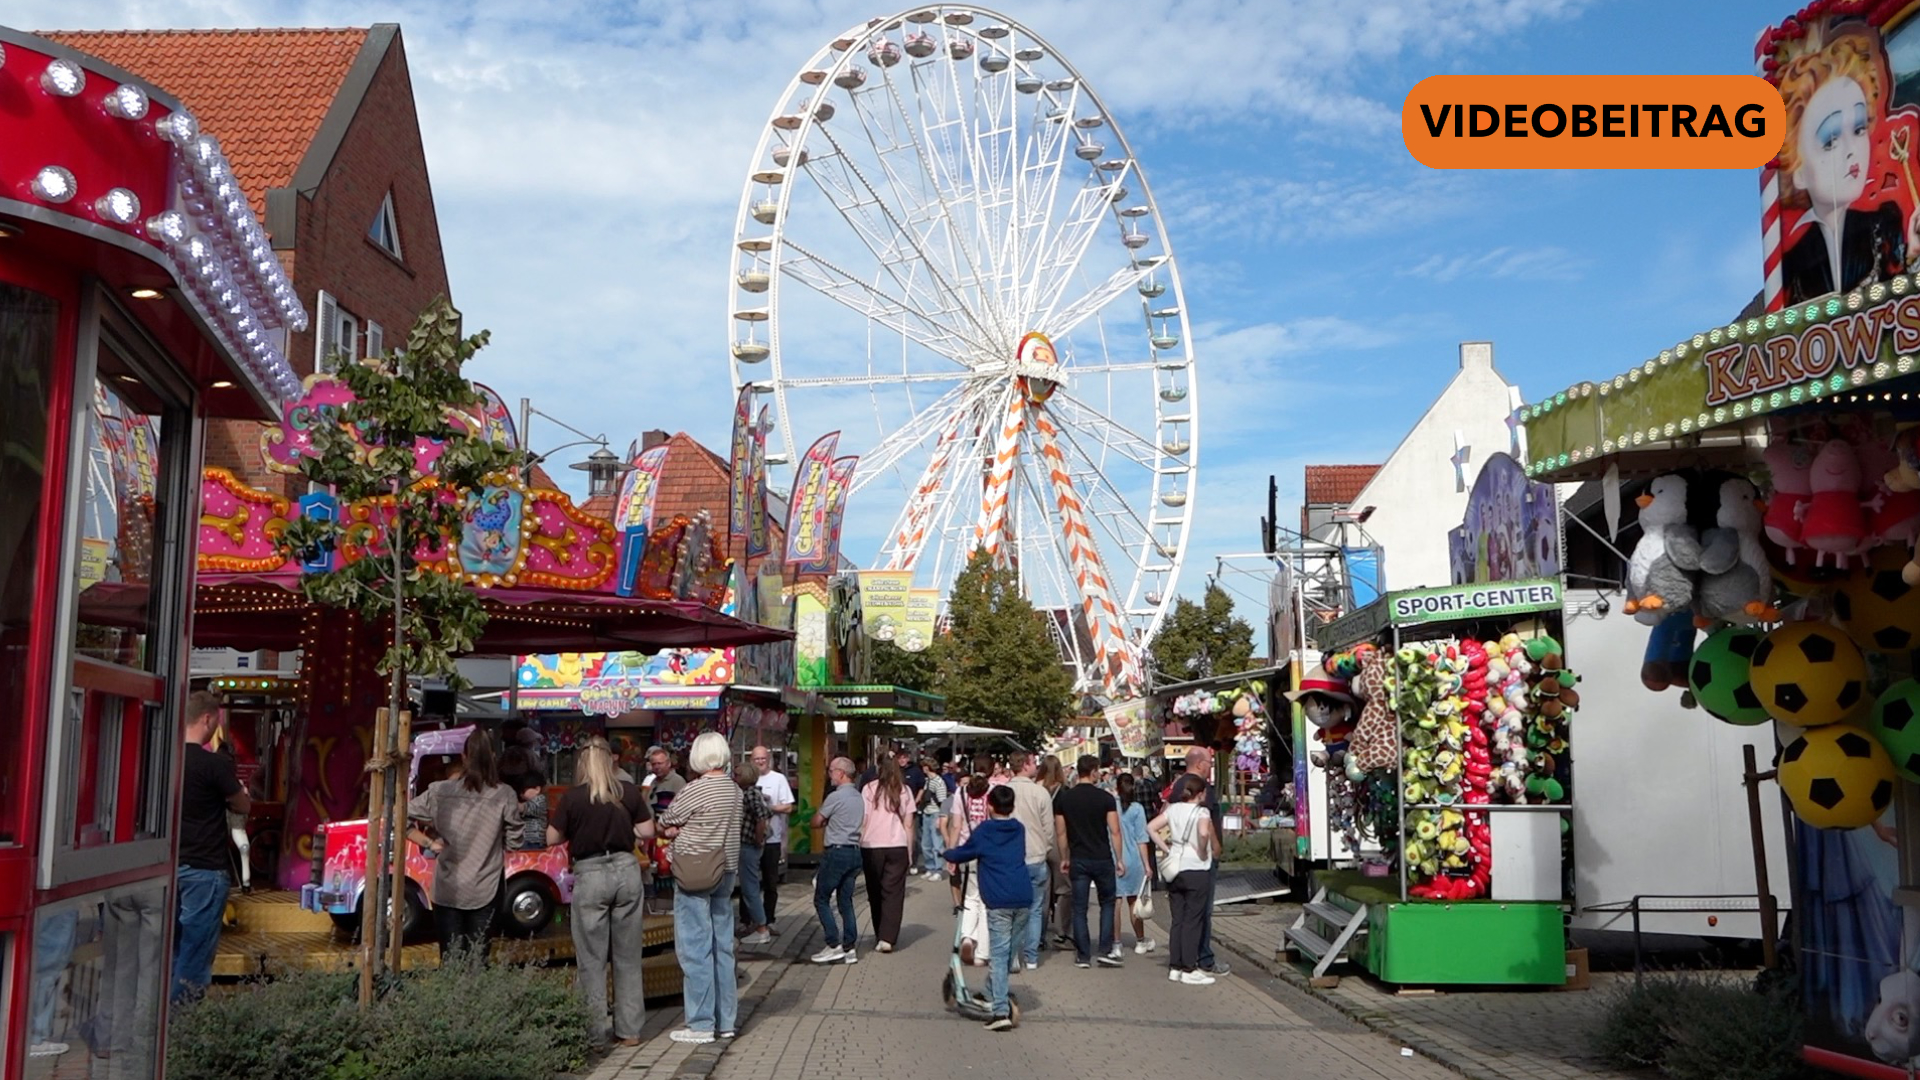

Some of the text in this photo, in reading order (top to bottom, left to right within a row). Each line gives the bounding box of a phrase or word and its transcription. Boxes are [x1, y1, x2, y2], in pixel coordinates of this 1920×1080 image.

[796, 461, 823, 554] GREIFEN!
[1397, 586, 1554, 616] SPORT-CENTER
[588, 699, 631, 711] MACHINE
